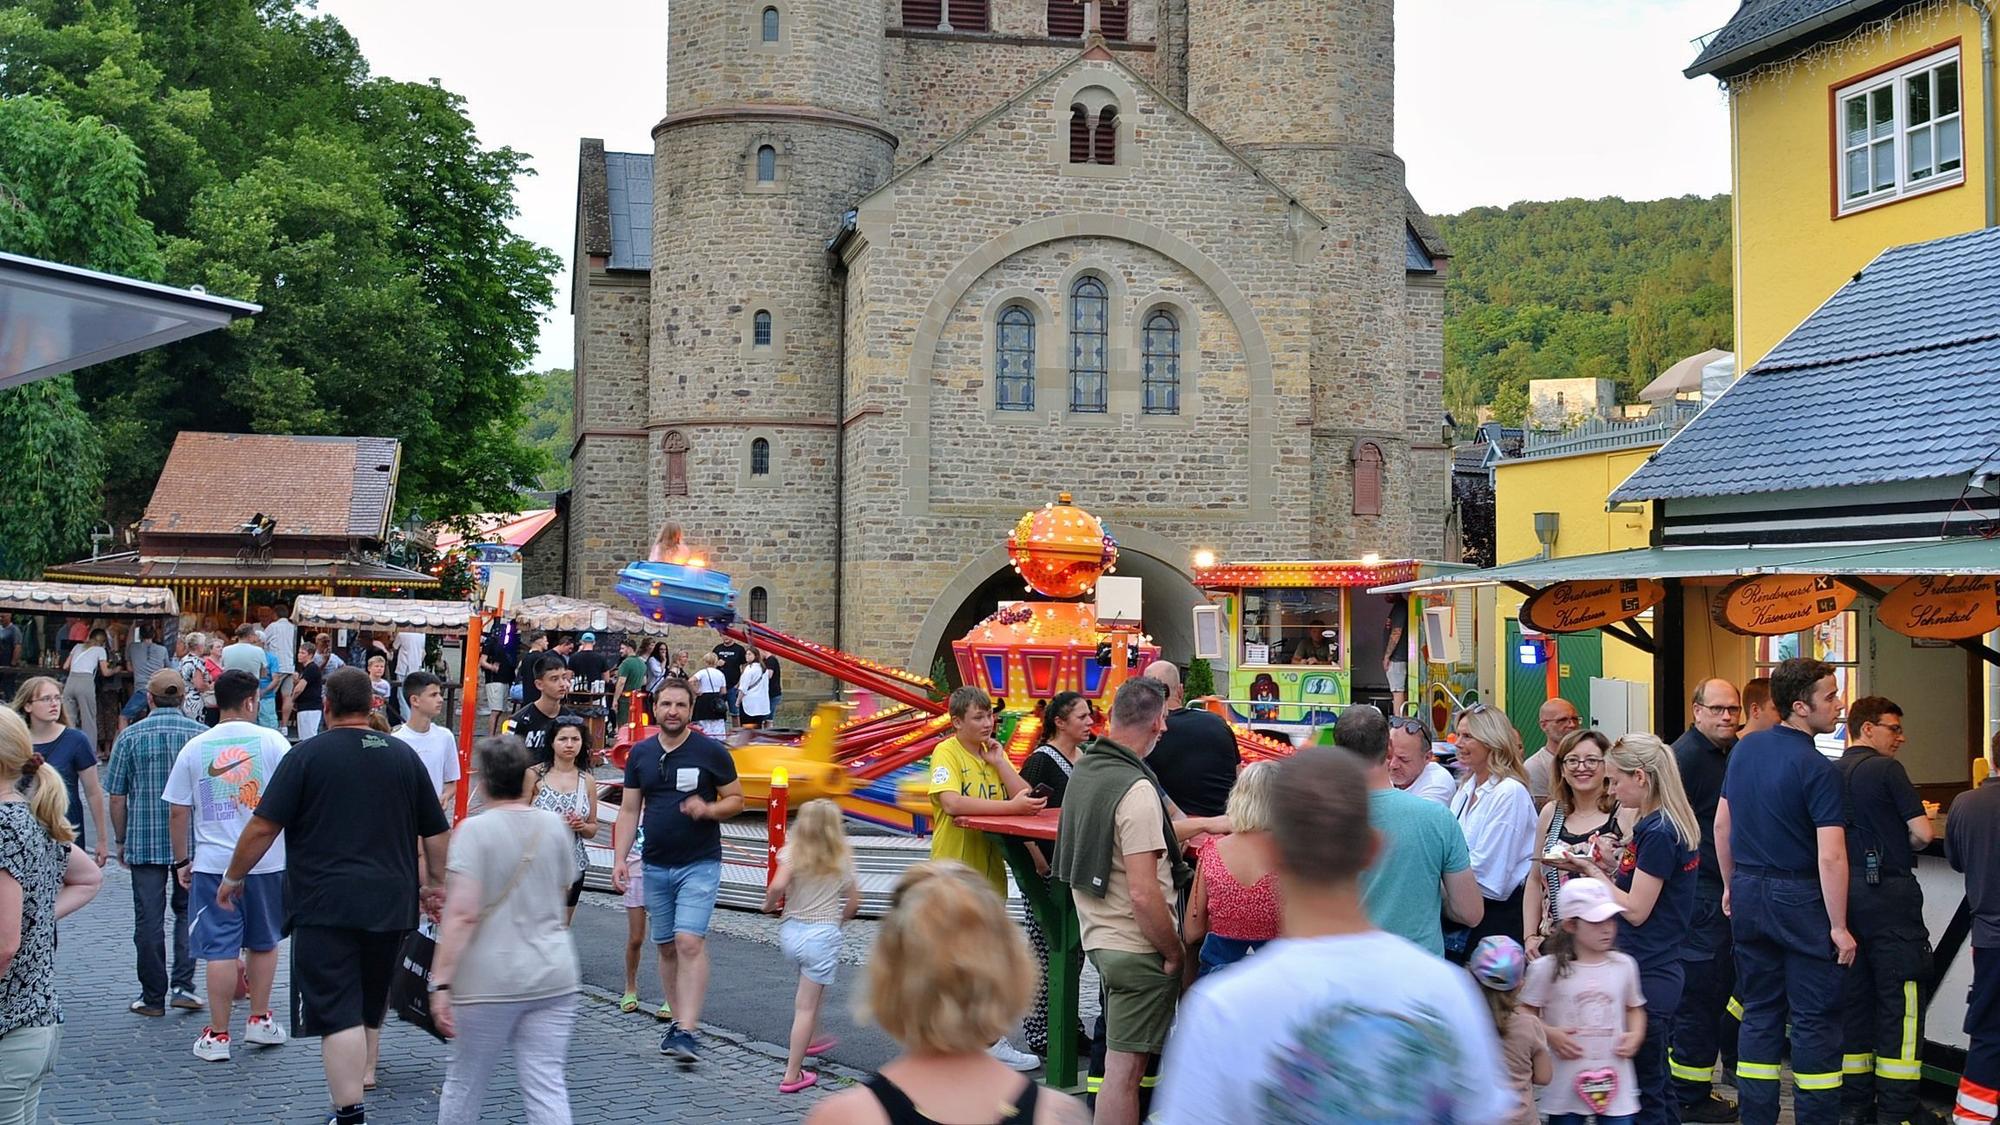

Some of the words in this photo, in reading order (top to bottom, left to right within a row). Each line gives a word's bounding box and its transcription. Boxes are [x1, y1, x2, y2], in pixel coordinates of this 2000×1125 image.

[1553, 584, 1613, 605] Bratwurst
[1740, 583, 1813, 606] Rindswurst
[1913, 576, 1991, 597] Frikadellen
[1553, 607, 1606, 629] Krakauer
[1747, 604, 1812, 627] Käsewurst
[1906, 602, 1980, 628] Schnitzel
